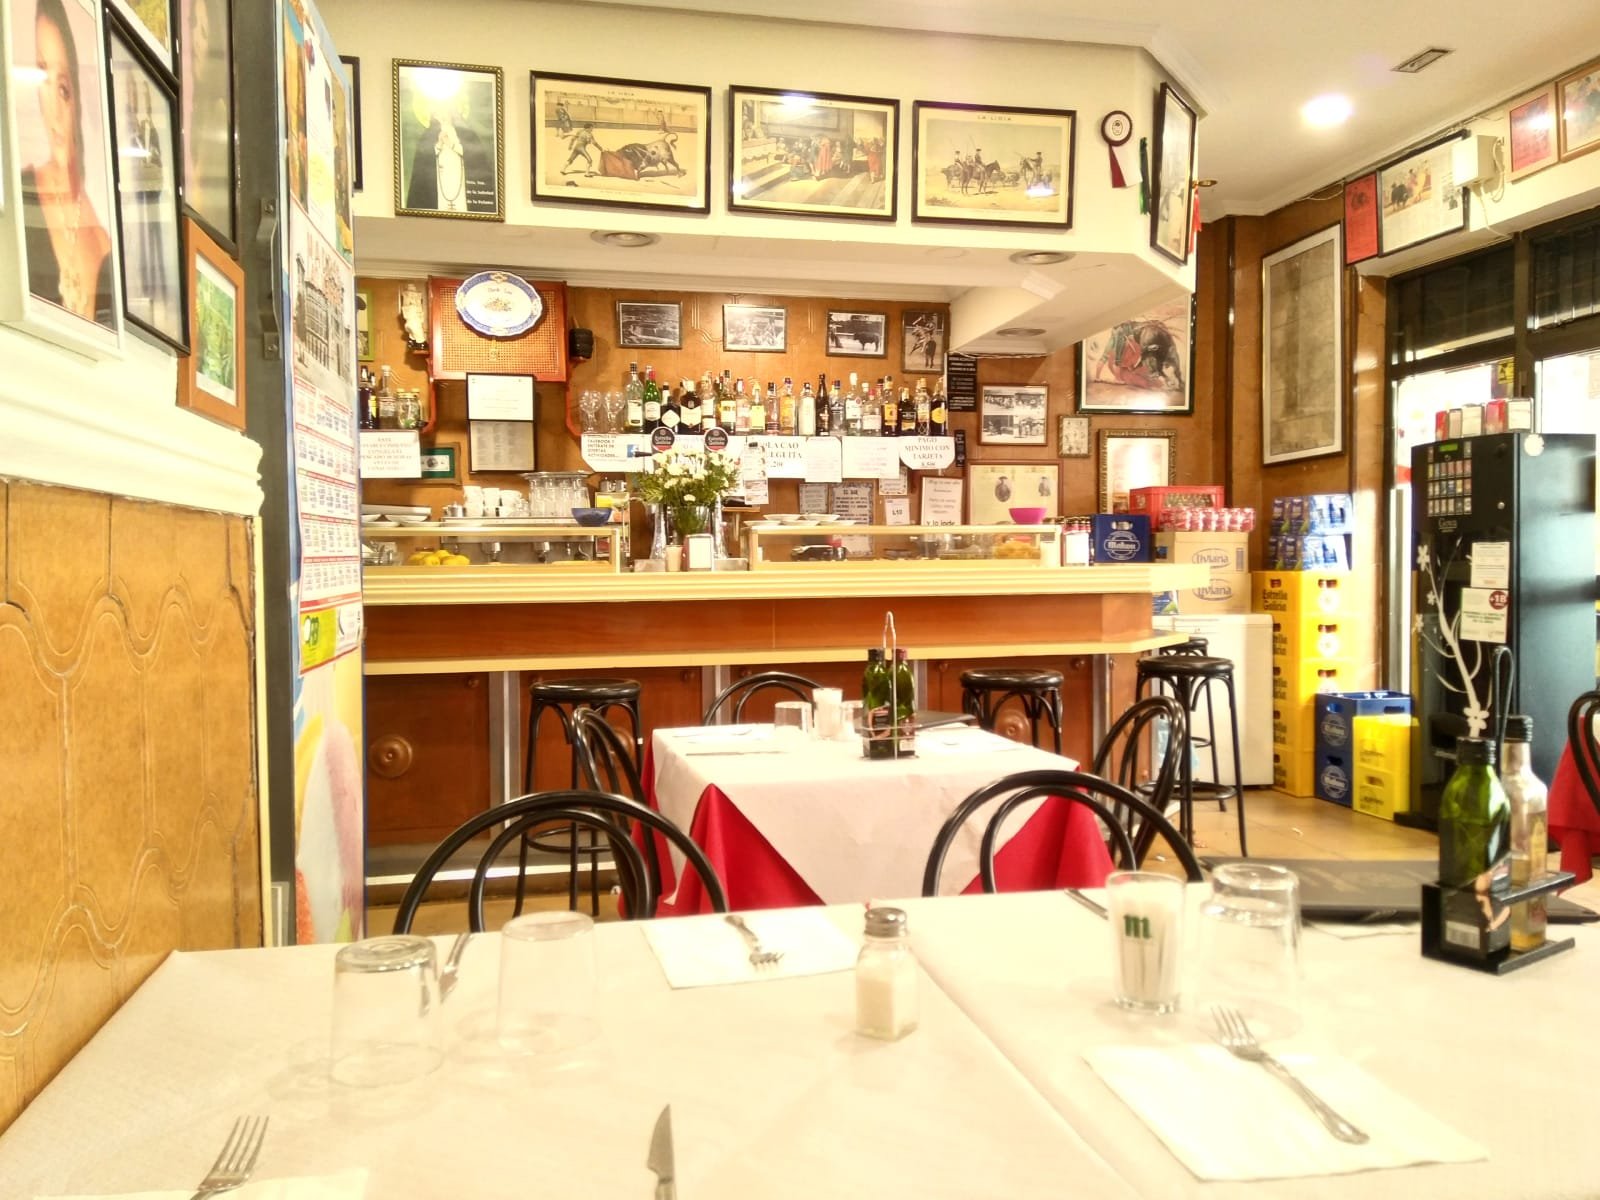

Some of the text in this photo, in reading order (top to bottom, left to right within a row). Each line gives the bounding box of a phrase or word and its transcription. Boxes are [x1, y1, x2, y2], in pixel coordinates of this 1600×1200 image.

[1262, 589, 1288, 600] Estrella
[1489, 594, 1507, 603] +18
[1263, 600, 1287, 611] Galicia
